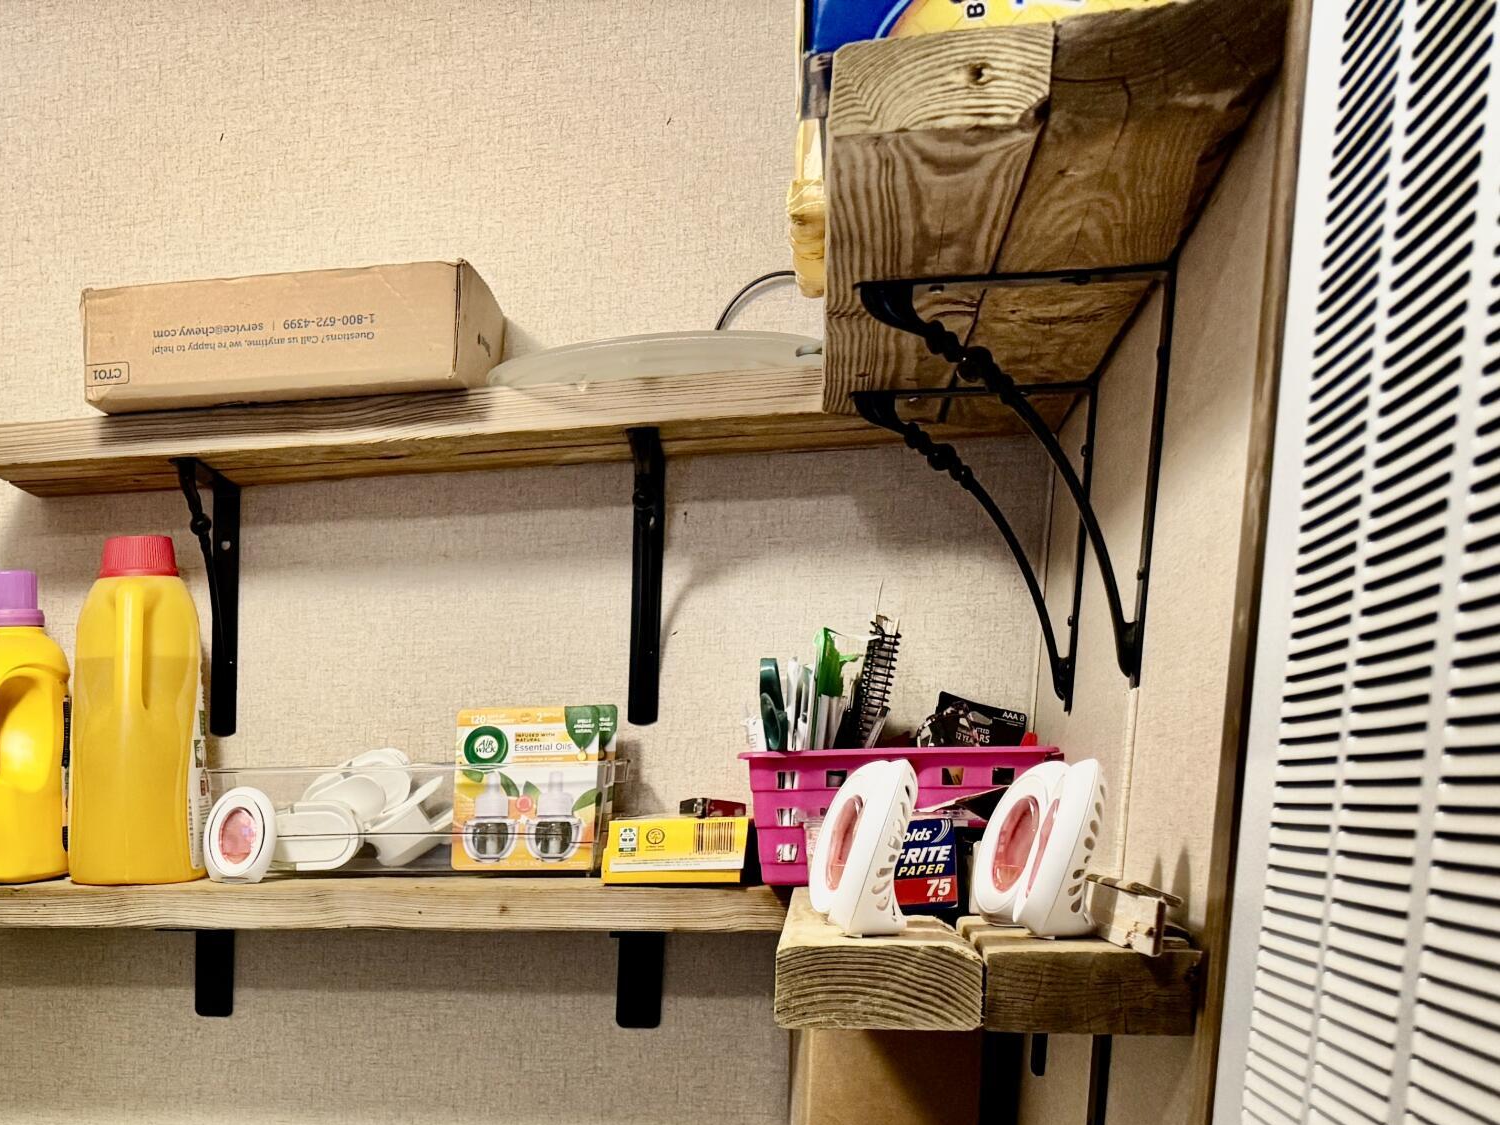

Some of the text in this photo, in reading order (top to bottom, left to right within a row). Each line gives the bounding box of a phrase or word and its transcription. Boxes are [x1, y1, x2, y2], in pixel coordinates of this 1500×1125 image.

[152, 313, 376, 339] 1-800-672-4399 service@chewy.com
[151, 331, 375, 356] Questions? Call us anytime, we're happy to help!
[1002, 711, 1018, 721] AAA
[514, 742, 573, 752] Essential Oils
[897, 863, 945, 877] PAPER
[926, 878, 952, 897] 75
